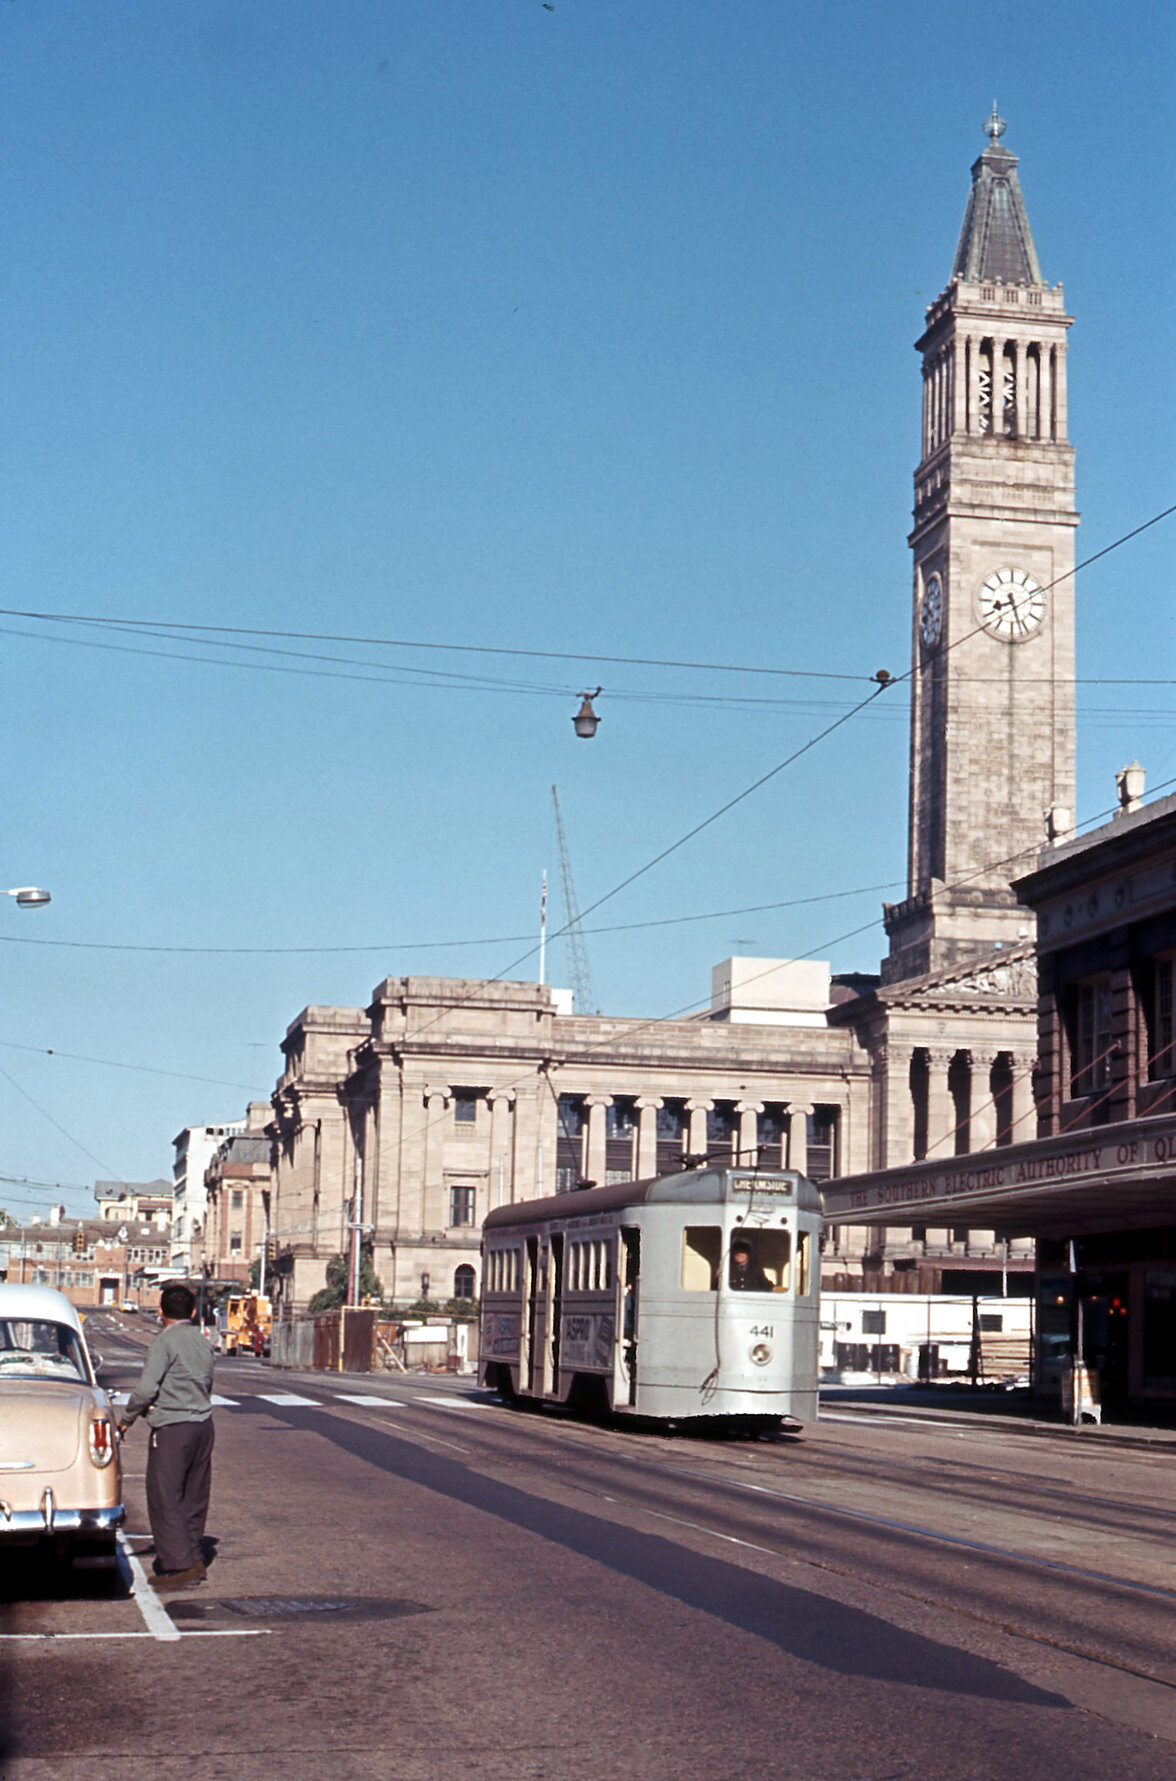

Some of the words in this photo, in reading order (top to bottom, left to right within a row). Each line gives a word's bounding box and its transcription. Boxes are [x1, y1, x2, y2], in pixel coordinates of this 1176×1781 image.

[851, 1191, 868, 1207] THE
[877, 1179, 936, 1203] SOUTHERN
[945, 1168, 1005, 1194] ELECTRIC
[1016, 1148, 1102, 1182] AUTHORITY
[1117, 1142, 1138, 1164] OF
[749, 1325, 774, 1338] 441
